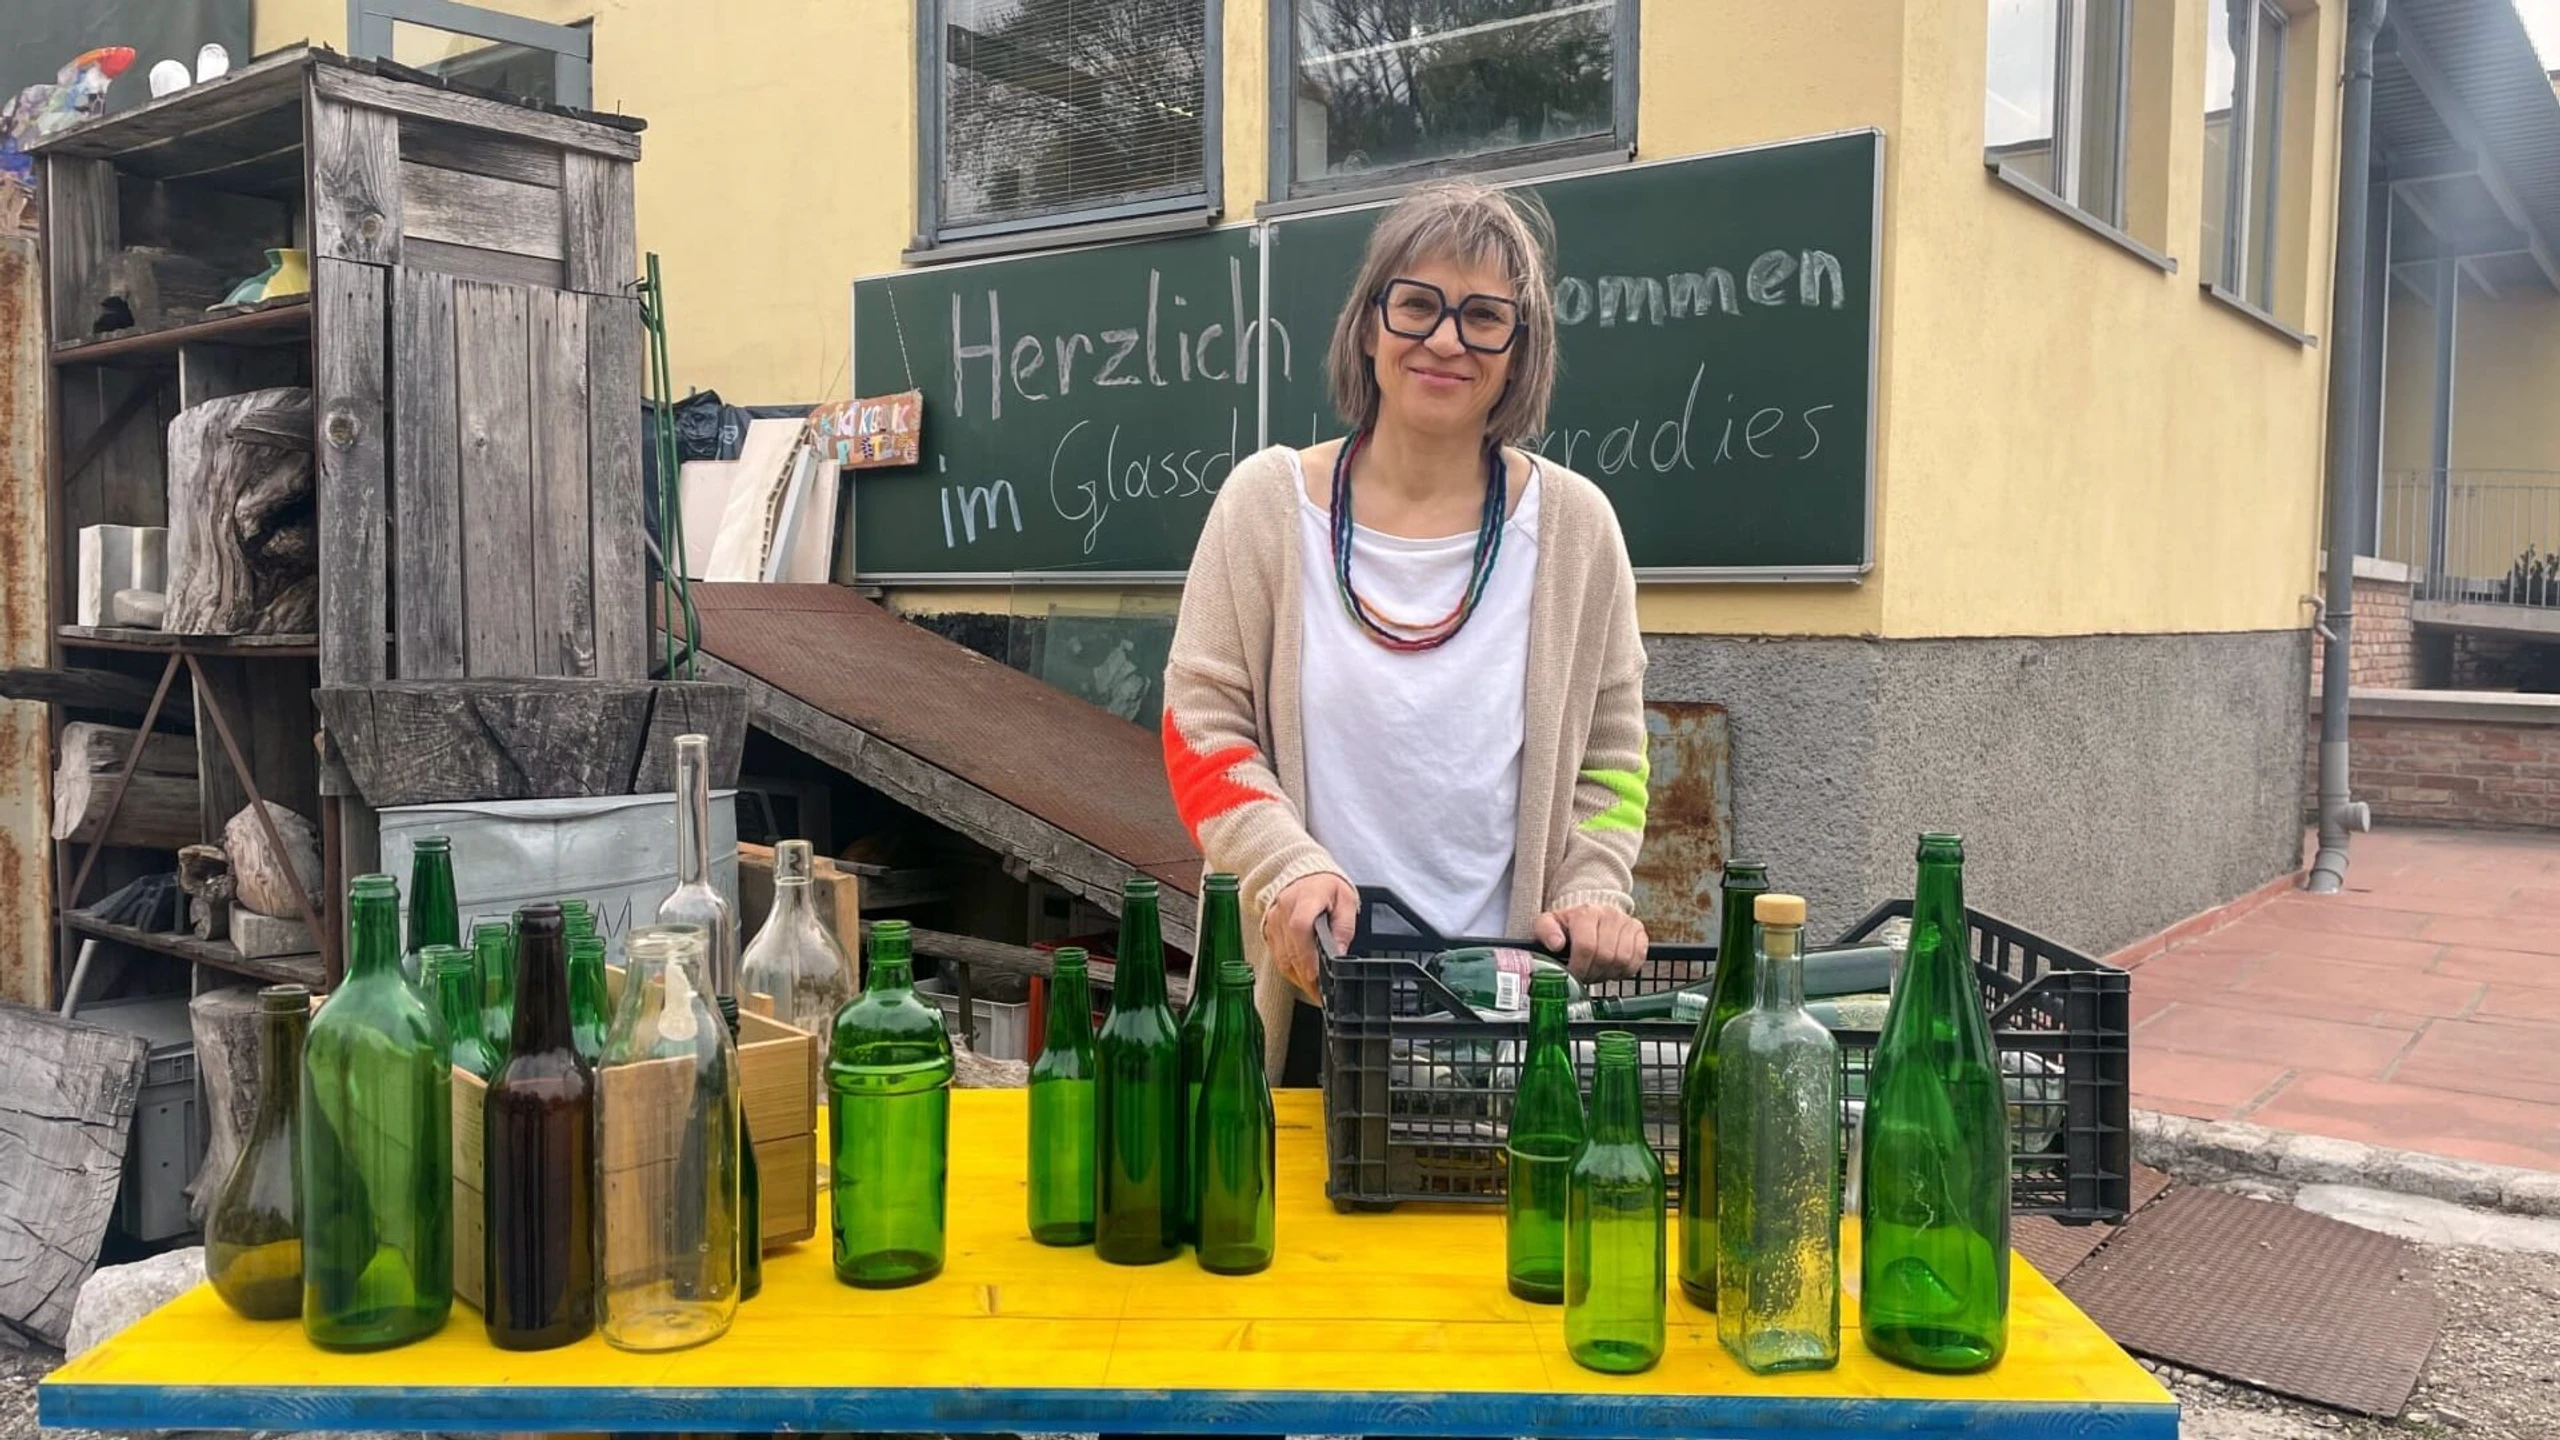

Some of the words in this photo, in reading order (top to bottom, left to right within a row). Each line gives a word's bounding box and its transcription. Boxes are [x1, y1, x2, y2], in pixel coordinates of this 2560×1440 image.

[952, 256, 1292, 420] Herzlich
[1554, 249, 1846, 328] ommen
[938, 453, 1023, 549] im
